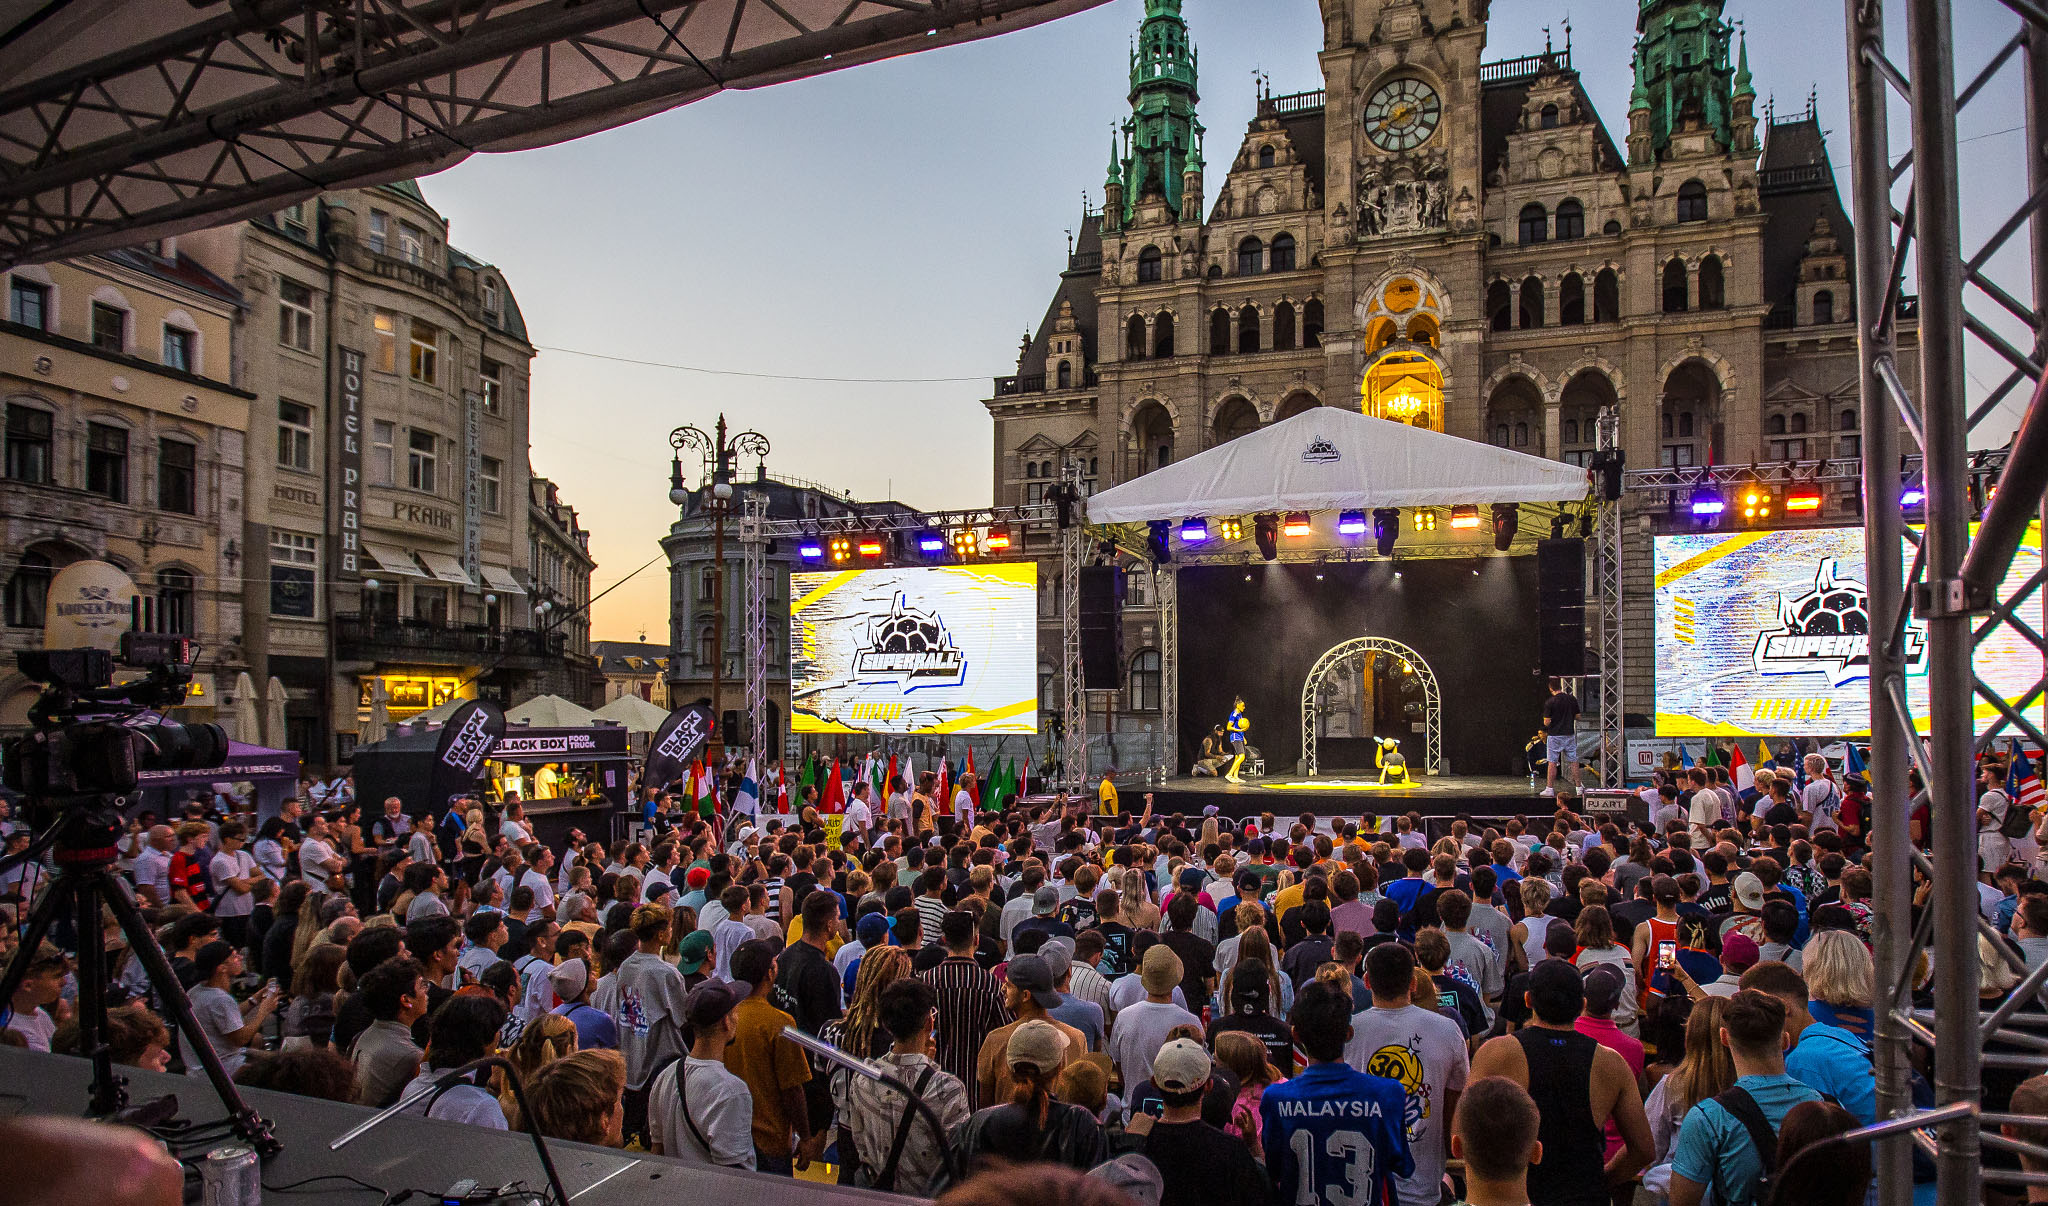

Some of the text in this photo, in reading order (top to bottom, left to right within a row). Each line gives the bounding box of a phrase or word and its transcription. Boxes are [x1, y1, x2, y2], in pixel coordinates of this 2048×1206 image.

[343, 353, 360, 572] HOTEL PRAHA
[469, 400, 477, 516] RESTAURANT
[274, 485, 321, 506] HOTEL
[393, 502, 452, 529] PRAHA
[1764, 634, 1923, 657] SUPERBL
[860, 652, 960, 670] SUPERBALL
[448, 711, 486, 763] BLACK
[478, 733, 495, 757] TRUCK
[540, 738, 566, 750] BOX
[569, 741, 596, 749] TRUCK
[661, 713, 699, 755] BLACK
[672, 730, 697, 756] BOX
[459, 732, 485, 766] BOX
[1588, 800, 1622, 808] PJ ART
[1370, 1054, 1405, 1079] 30
[1278, 1101, 1383, 1118] MALAYSIA
[1290, 1128, 1375, 1206] 13
